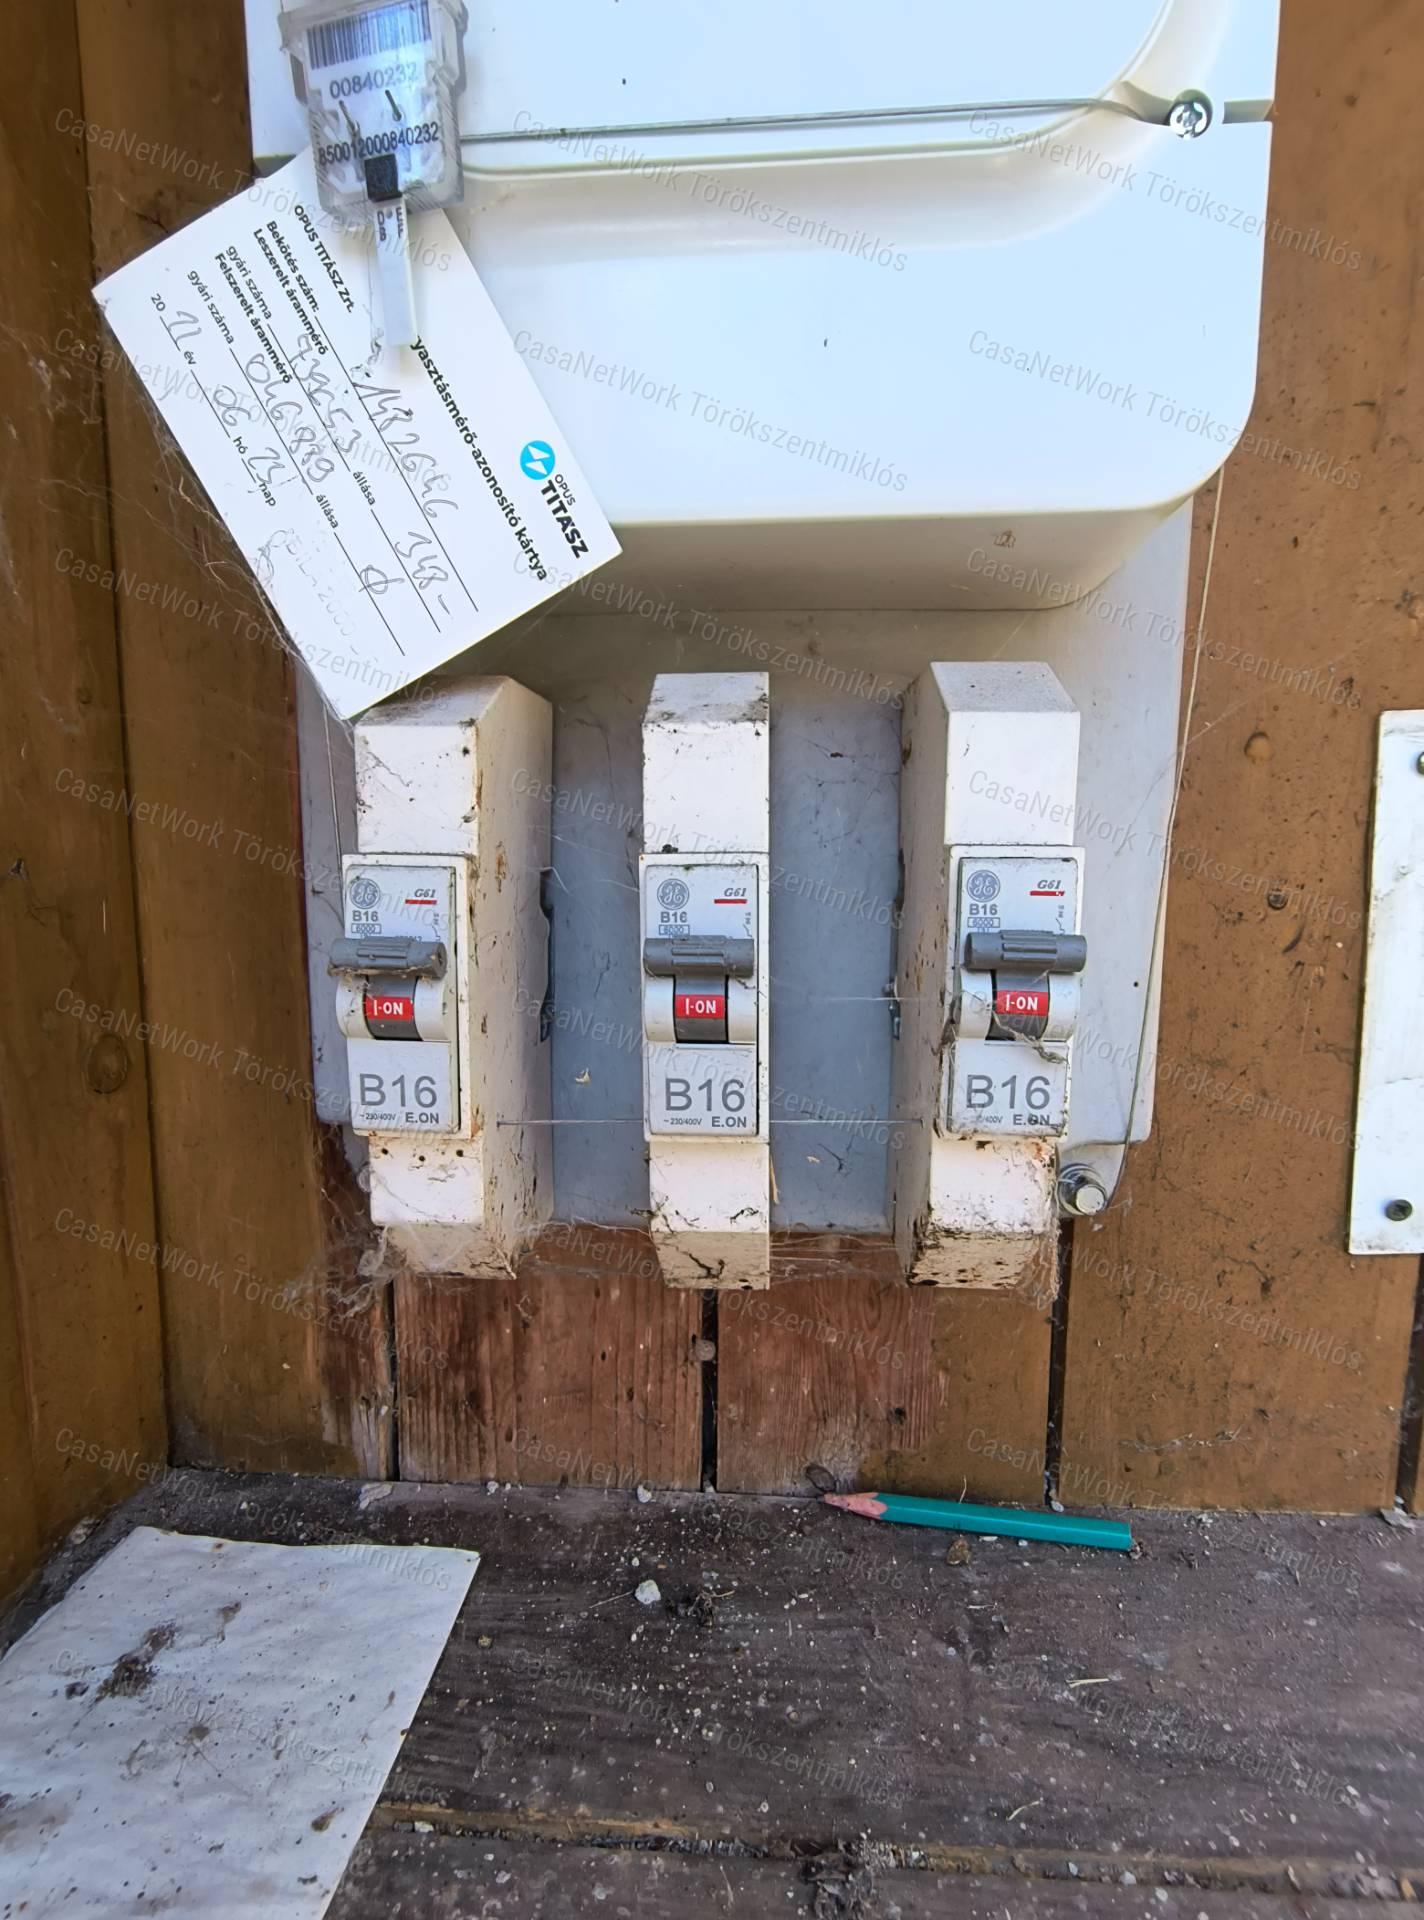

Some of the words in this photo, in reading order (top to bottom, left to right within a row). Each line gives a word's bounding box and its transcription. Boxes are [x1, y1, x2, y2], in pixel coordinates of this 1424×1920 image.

[330, 62, 418, 99] 00840232
[294, 205, 319, 242] OPUS
[314, 241, 345, 289] TITÁSZ
[338, 286, 355, 313] Zrt.
[226, 246, 252, 277] gyári
[246, 278, 272, 320] száma
[253, 228, 291, 288] Leszerelt
[286, 288, 328, 356] árammérő
[296, 274, 320, 313] szám:
[150, 293, 166, 312] 20
[187, 270, 213, 302] gyári
[208, 303, 234, 345] száma
[215, 253, 253, 317] Felszerelt
[250, 317, 293, 384] árammérő
[184, 350, 197, 366] év
[232, 436, 248, 454] hó
[410, 335, 522, 528] yasztásmérő-azonosító
[514, 525, 549, 581] kártya
[258, 482, 276, 507] nap
[352, 471, 376, 506] állása
[554, 473, 576, 507] OPUS
[315, 494, 339, 529] állása
[541, 480, 589, 559] TITÁSZ
[352, 910, 379, 922] B16
[660, 912, 688, 924] B16
[968, 903, 998, 915] B16
[359, 1073, 438, 1108] B16
[665, 1077, 745, 1112] B16
[966, 1074, 1050, 1110] B16
[405, 1112, 440, 1123] E.ON
[711, 1116, 747, 1128] E.ON
[1012, 1114, 1050, 1126] E.ON
